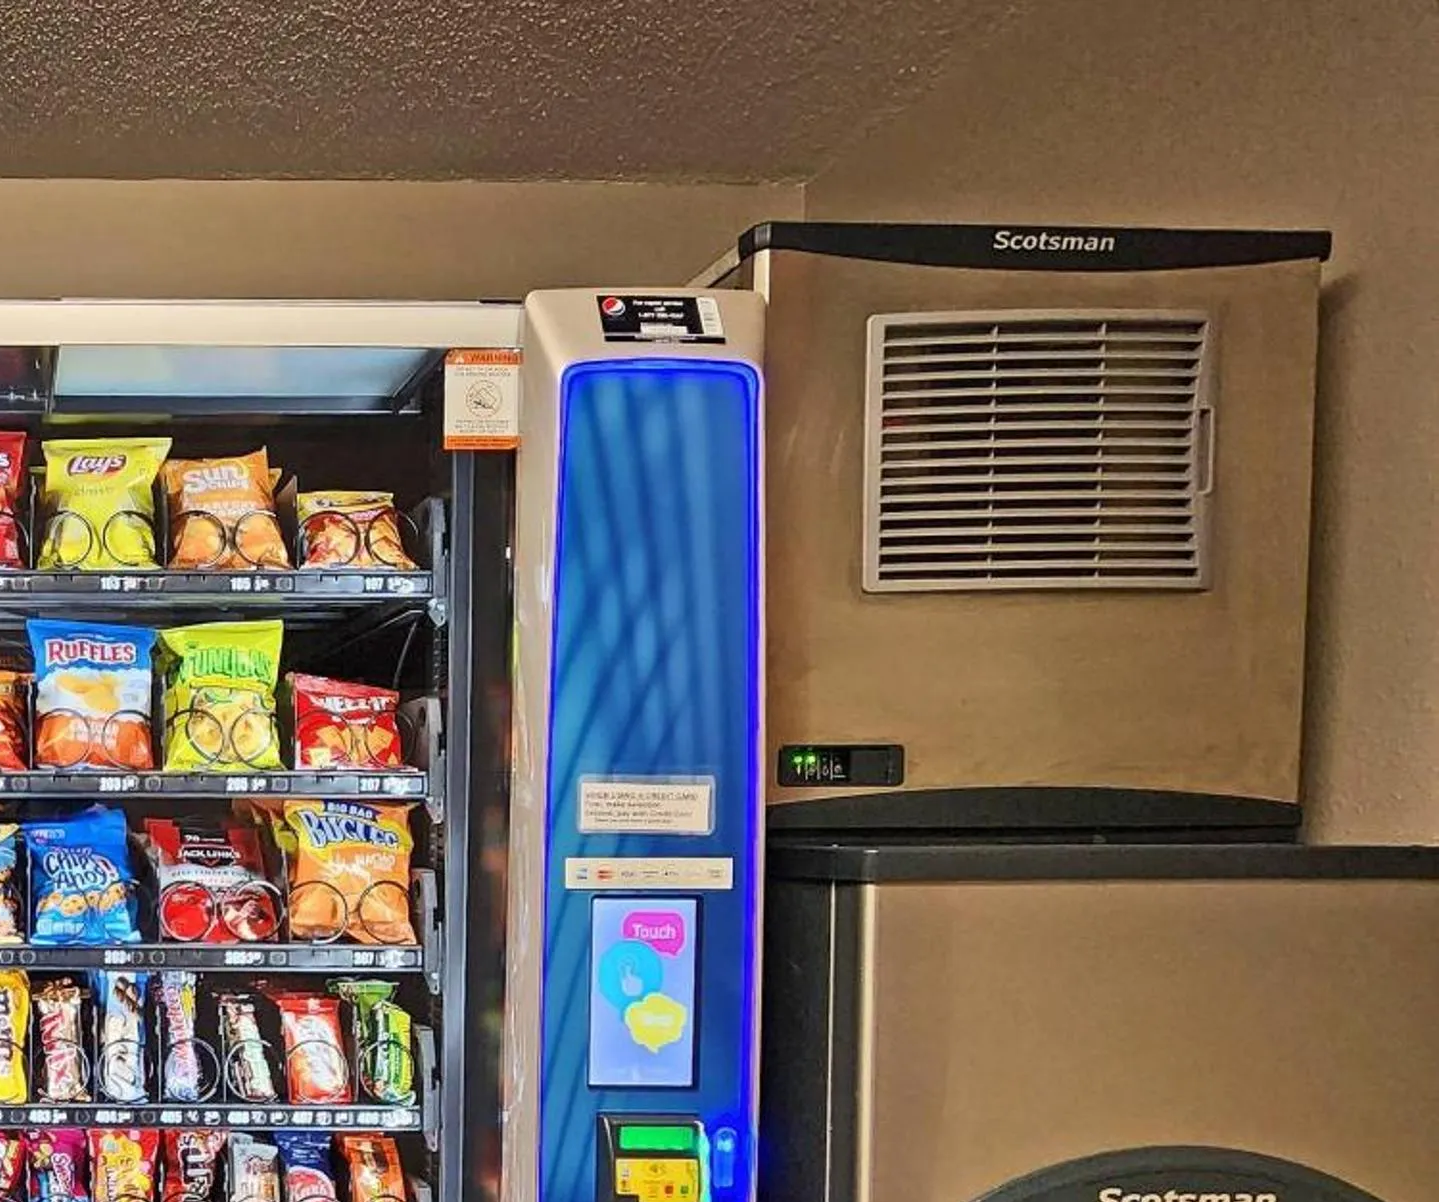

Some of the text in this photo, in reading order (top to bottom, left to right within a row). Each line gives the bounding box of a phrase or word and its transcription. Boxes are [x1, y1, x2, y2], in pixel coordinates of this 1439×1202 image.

[993, 230, 1116, 251] Scotsman
[46, 639, 137, 664] RUFFLES
[632, 923, 676, 940] Touch
